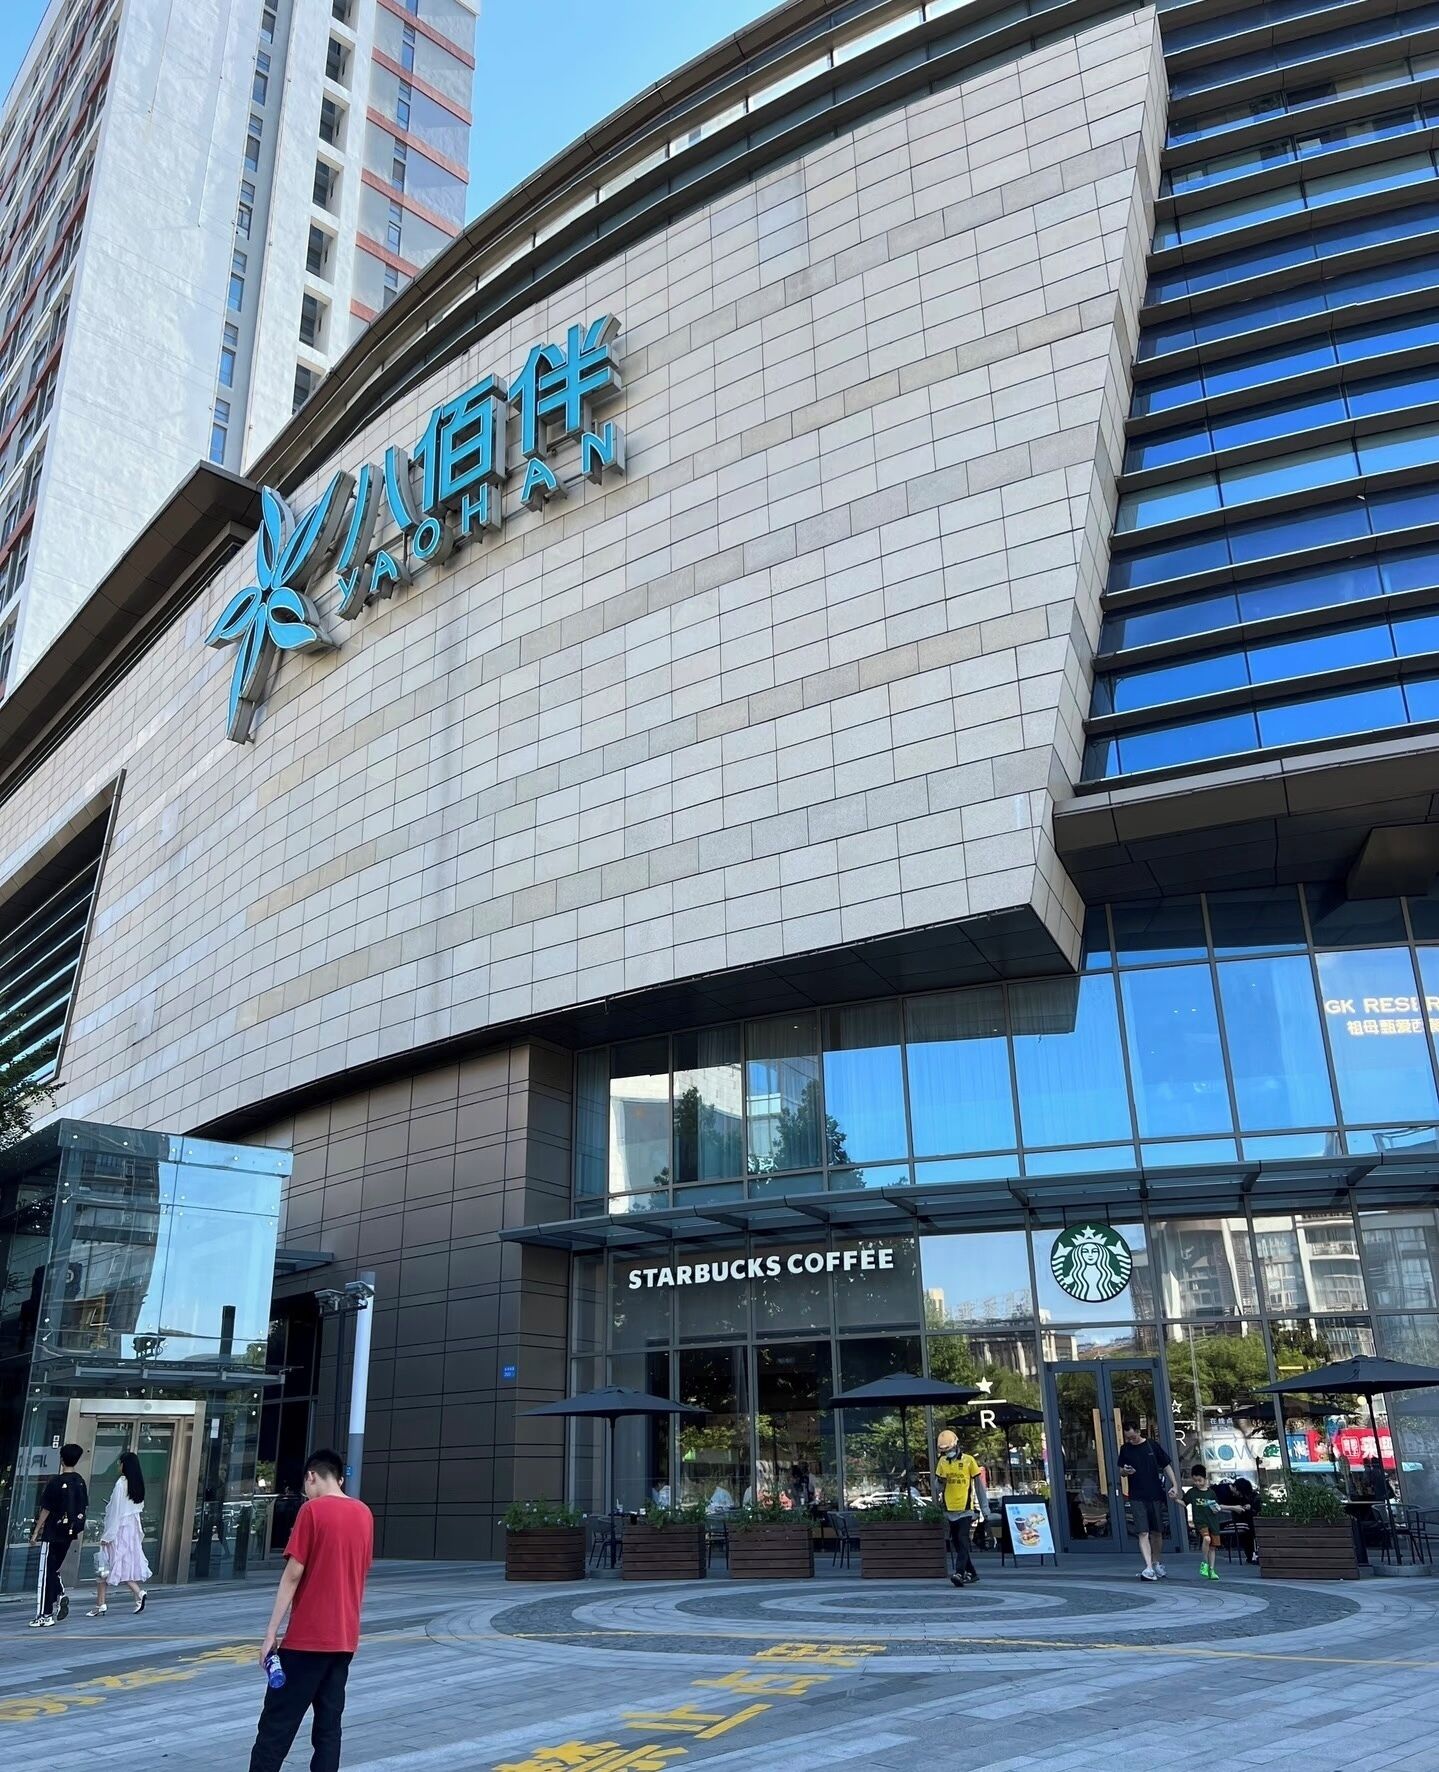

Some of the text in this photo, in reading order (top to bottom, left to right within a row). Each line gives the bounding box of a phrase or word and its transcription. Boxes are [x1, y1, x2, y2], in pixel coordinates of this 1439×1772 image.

[337, 313, 619, 573] 八佰伴
[337, 421, 622, 618] YAOHAN
[1325, 999, 1355, 1014] GK
[628, 1248, 894, 1289] STARBUCKS COFFEE
[980, 1410, 997, 1429] R
